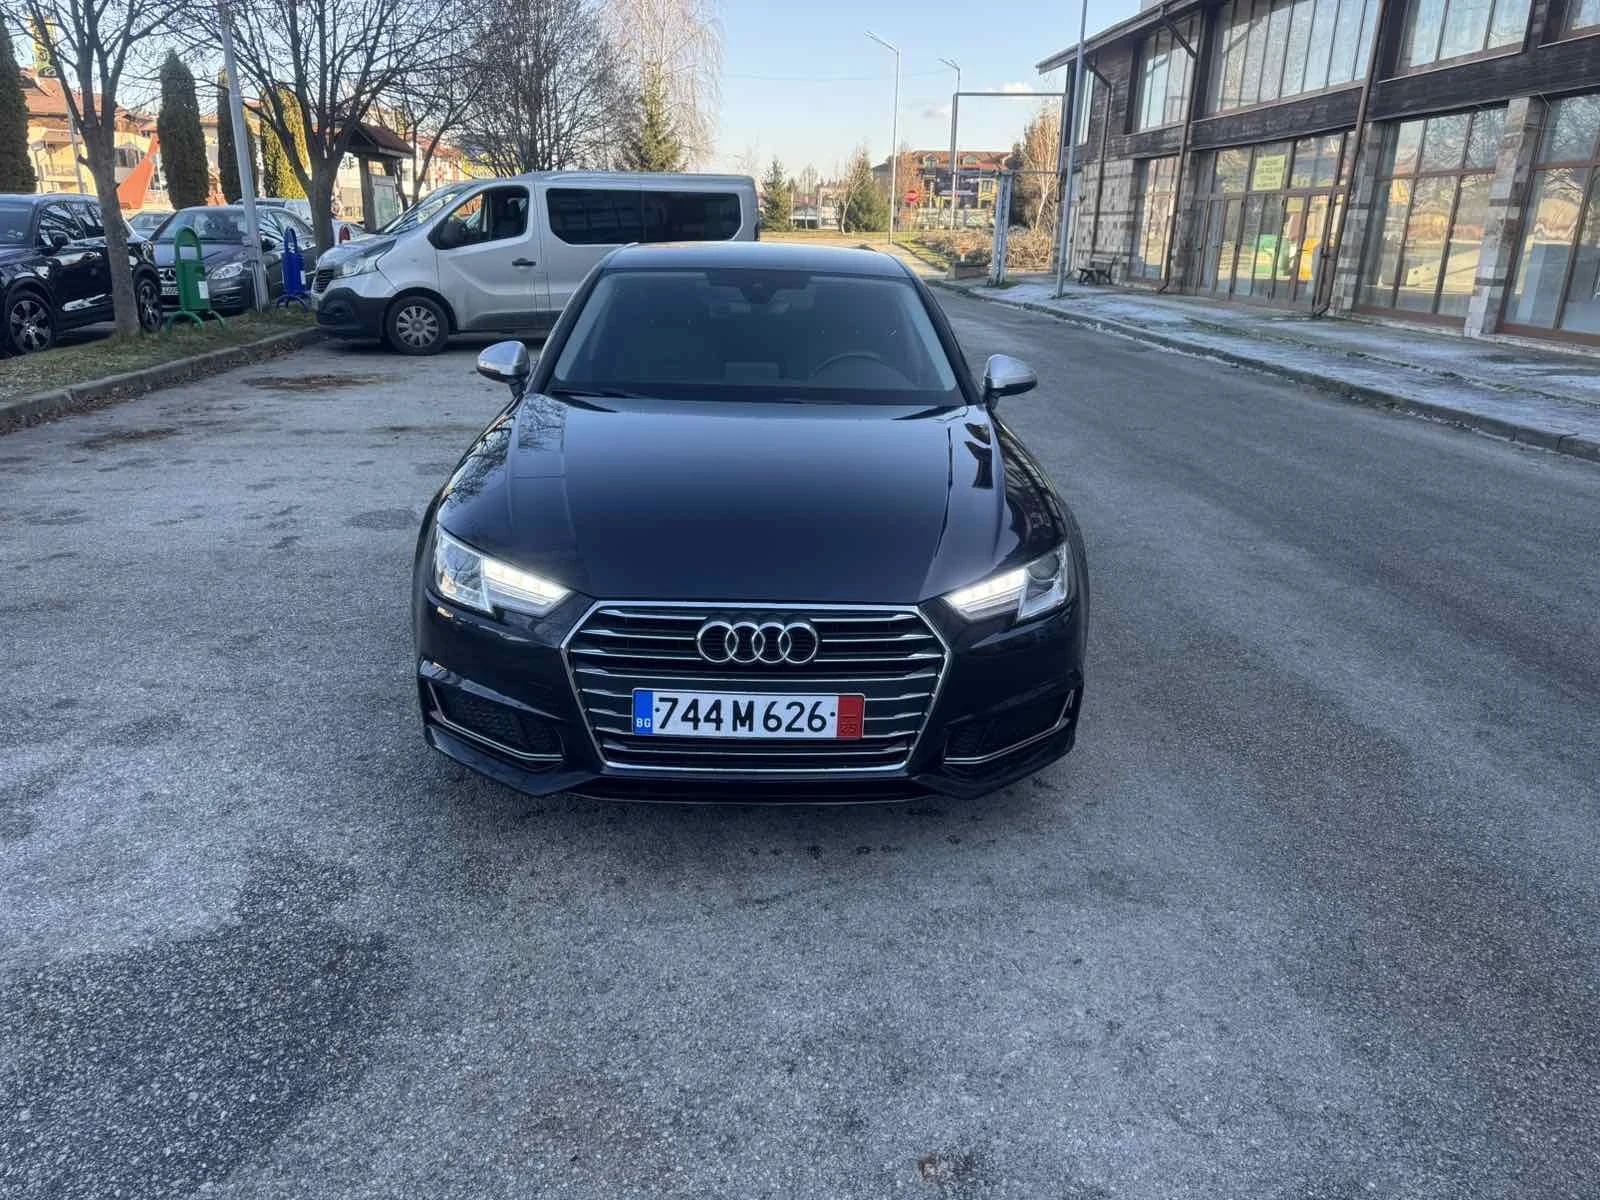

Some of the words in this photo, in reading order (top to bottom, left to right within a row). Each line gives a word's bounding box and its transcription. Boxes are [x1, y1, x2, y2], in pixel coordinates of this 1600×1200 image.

[636, 718, 651, 728] BG
[658, 697, 724, 731] 744
[732, 700, 754, 732] M
[762, 700, 828, 733] 626
